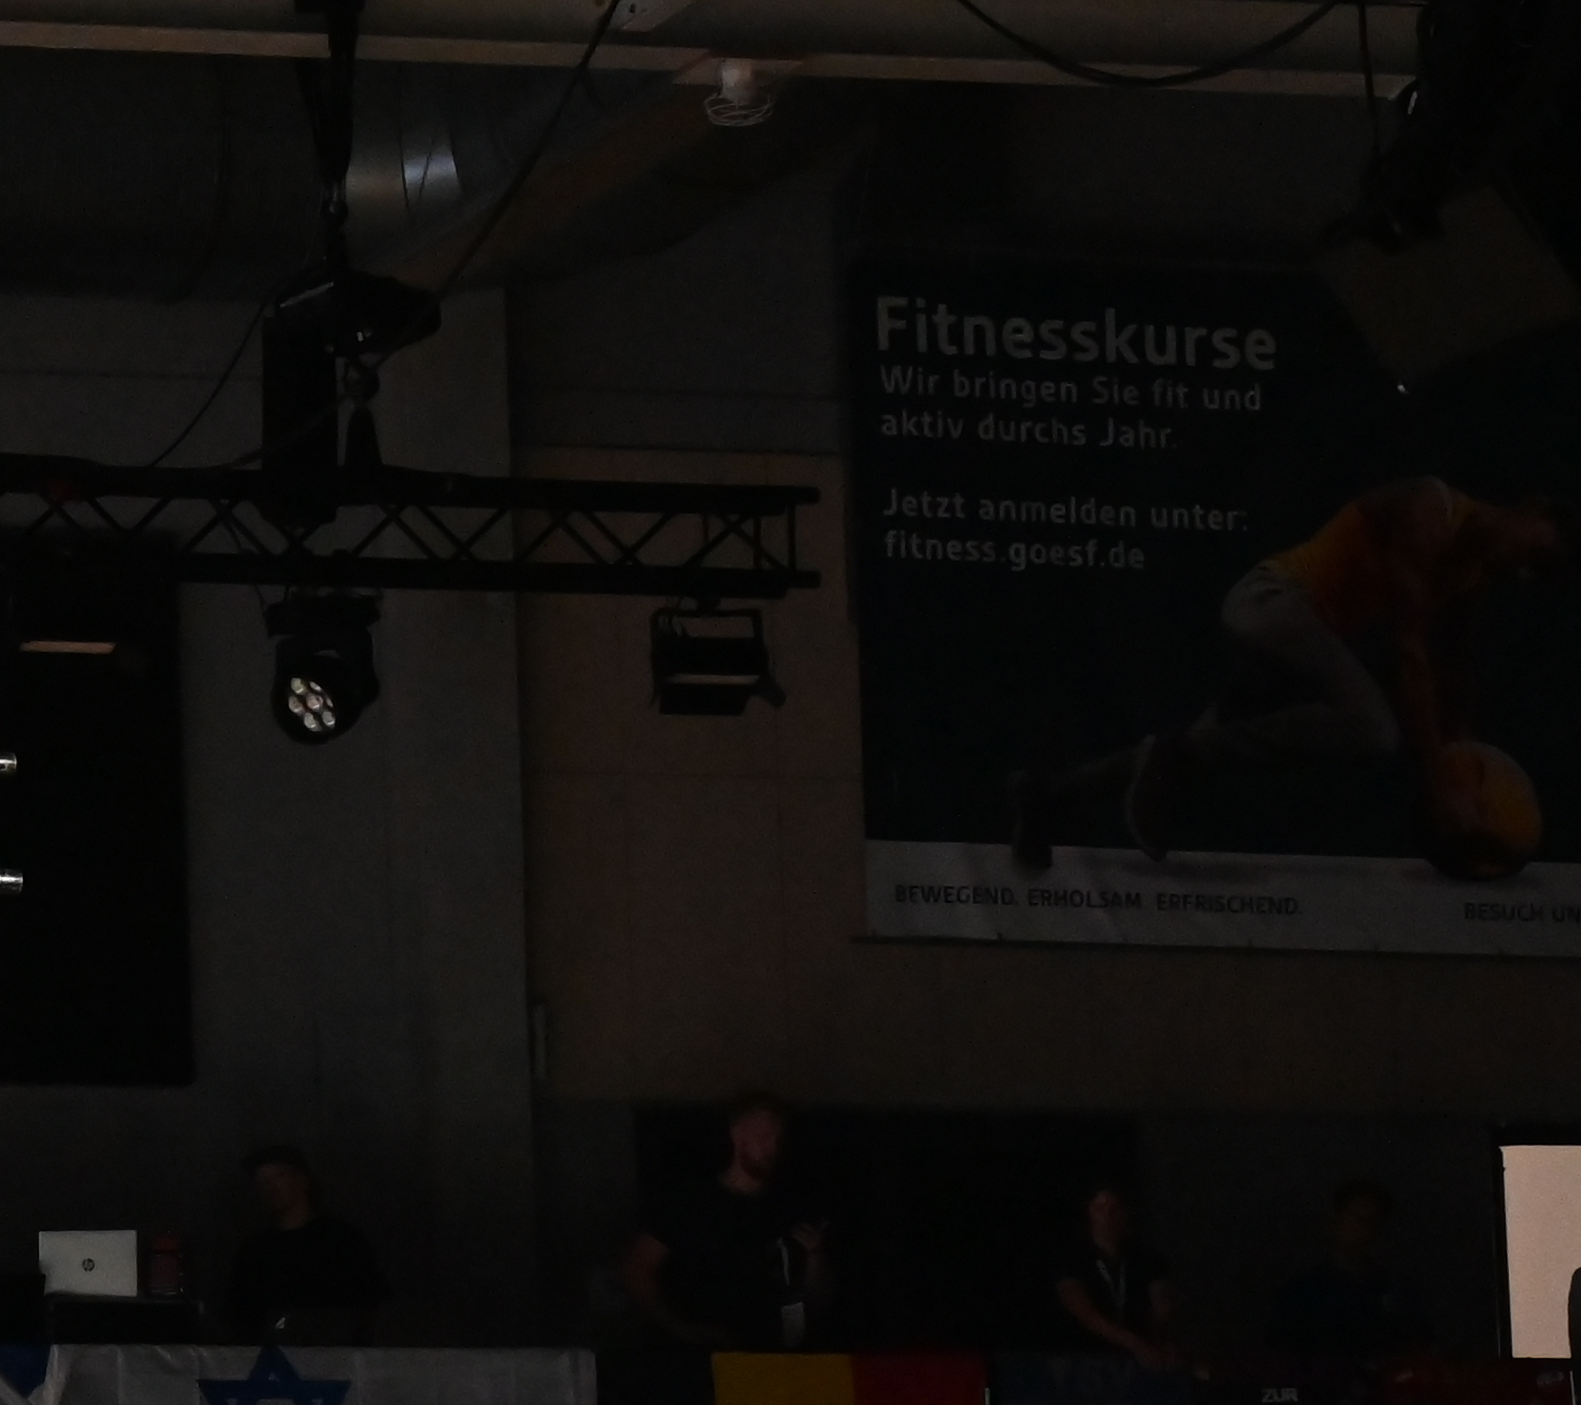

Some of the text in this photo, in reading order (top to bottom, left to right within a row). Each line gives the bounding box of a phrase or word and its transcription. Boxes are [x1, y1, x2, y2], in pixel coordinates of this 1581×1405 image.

[877, 295, 1278, 371] Fitnesskurse
[880, 364, 1263, 412] Wir bringen Sie fit und
[880, 410, 1178, 450] aktiv durchs Jahr.
[883, 487, 1249, 532] Jetzt anmelden unter:
[884, 531, 1146, 571] fitness.goesf.de
[1463, 902, 1543, 922] BESUCH
[1260, 1386, 1300, 1405] ZUR
